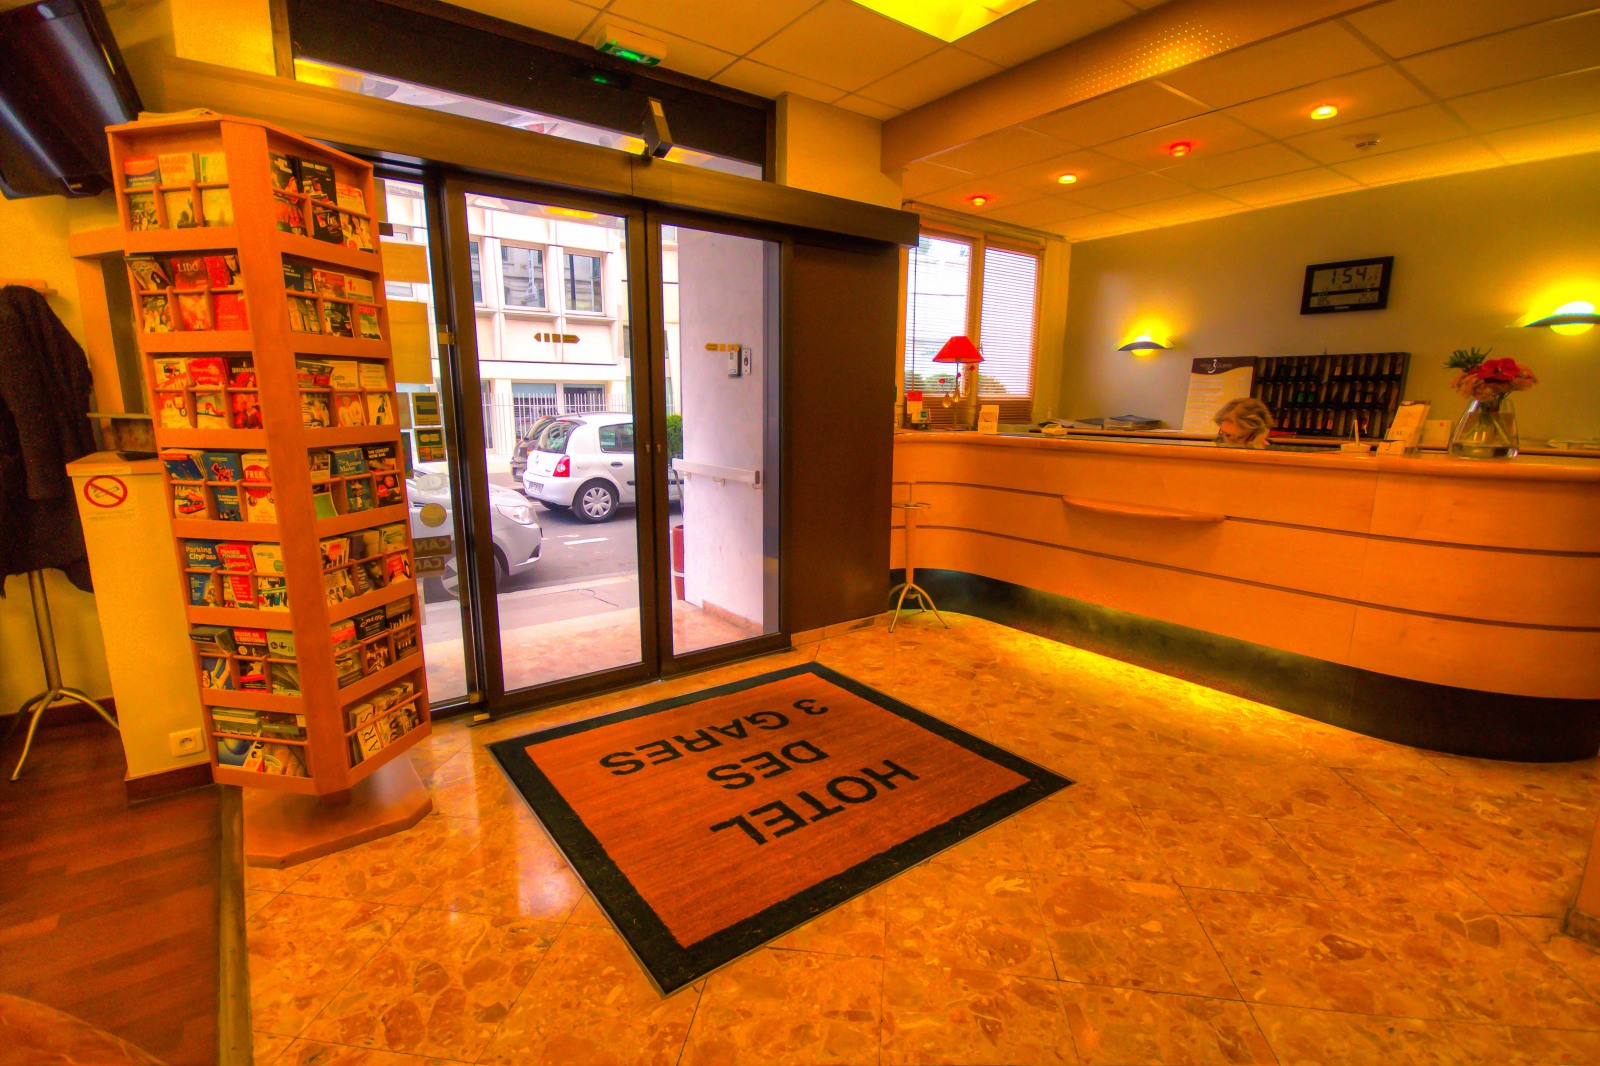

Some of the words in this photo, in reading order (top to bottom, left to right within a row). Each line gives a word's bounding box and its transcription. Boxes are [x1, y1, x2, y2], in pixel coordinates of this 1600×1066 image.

[245, 470, 264, 479] FREE
[185, 546, 212, 554] Parking
[189, 553, 217, 561] CityPass
[793, 699, 829, 715] 3
[599, 710, 790, 776] GARES
[707, 739, 830, 789] DES
[709, 759, 920, 846] HOTEL
